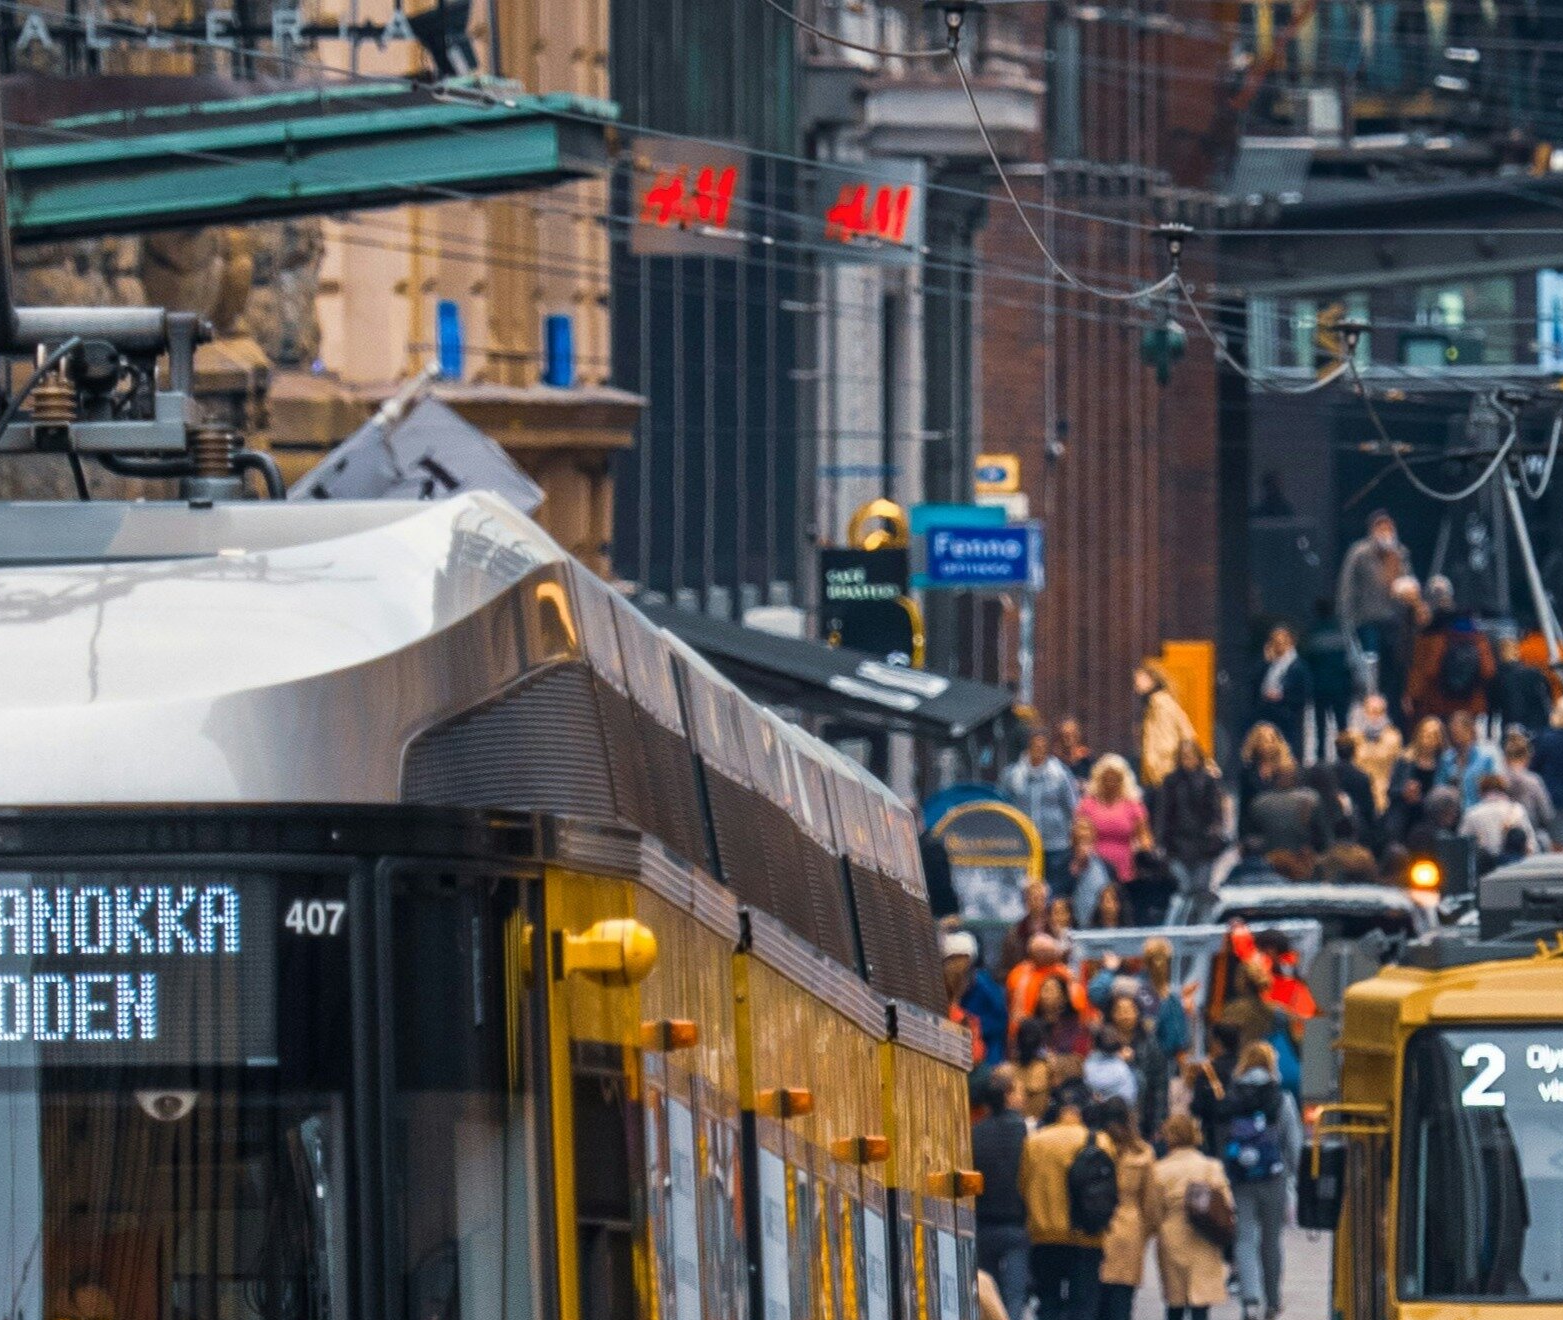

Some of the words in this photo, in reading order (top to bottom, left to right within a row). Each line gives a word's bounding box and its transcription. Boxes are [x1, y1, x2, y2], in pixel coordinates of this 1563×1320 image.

[15, 8, 421, 50] ALLERIA
[285, 901, 346, 935] 407
[1461, 1042, 1506, 1107] 2
